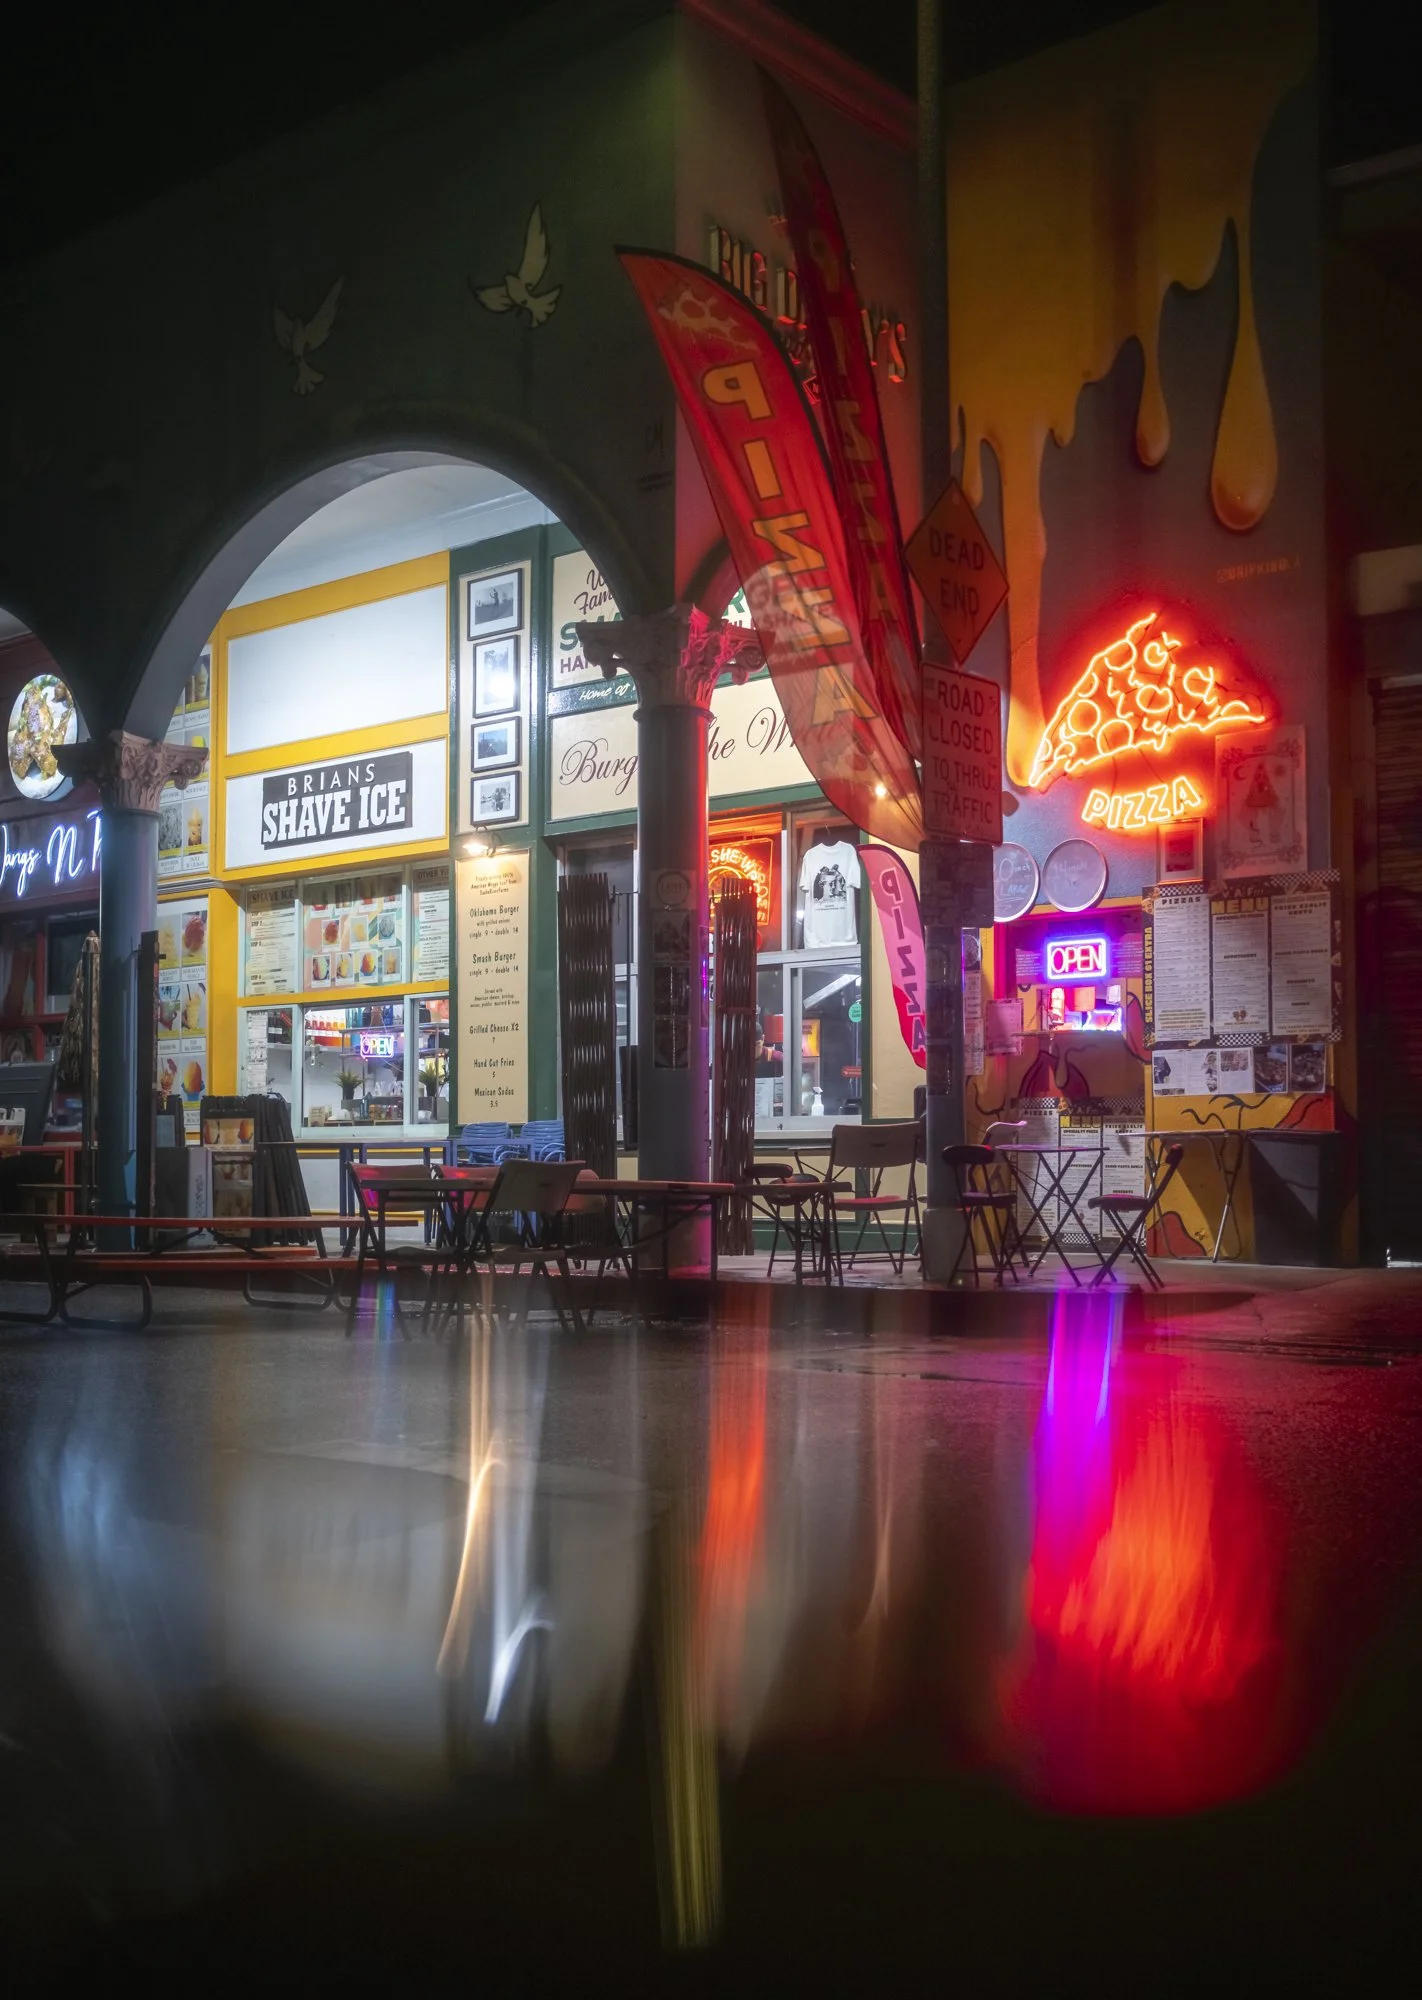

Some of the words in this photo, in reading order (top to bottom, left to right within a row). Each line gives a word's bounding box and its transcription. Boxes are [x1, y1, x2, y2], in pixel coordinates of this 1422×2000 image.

[929, 526, 985, 572] DEAD
[939, 577, 980, 616] END
[937, 680, 985, 717] ROAD
[287, 763, 376, 796] BRIANS
[932, 756, 950, 781] TO
[953, 760, 992, 791] THRU
[262, 789, 352, 844] SHAVE
[358, 779, 407, 829] ICE
[932, 790, 994, 824] TRAFFIC
[1080, 775, 1203, 830] PIZZA
[1161, 897, 1202, 905] PIZZAS
[1211, 898, 1269, 914] MENU
[469, 908, 497, 918] Oklahoma
[499, 904, 520, 916] Burger
[469, 932, 482, 940] single
[495, 928, 510, 936] double
[513, 926, 519, 934] 14
[1144, 927, 1153, 959] EXTRA
[472, 952, 492, 964] Smash
[494, 951, 517, 963] Burger
[1050, 944, 1104, 974] OPEN
[469, 969, 482, 977] single
[495, 966, 510, 974] double
[513, 965, 519, 973] 14
[1144, 972, 1153, 992] BOX
[1144, 993, 1153, 1023] SLICE
[469, 1024, 489, 1035] Grilled
[489, 1023, 509, 1033] Cheese
[510, 1022, 520, 1032] X2
[362, 1036, 393, 1055] OPEN
[473, 1059, 487, 1068] Hand
[488, 1058, 499, 1067] Cut
[500, 1057, 515, 1067] Fries
[474, 1087, 496, 1097] Mexican
[497, 1086, 514, 1096] Sodas
[490, 1100, 499, 1108] 3.5
[1060, 1115, 1102, 1128] MENU
